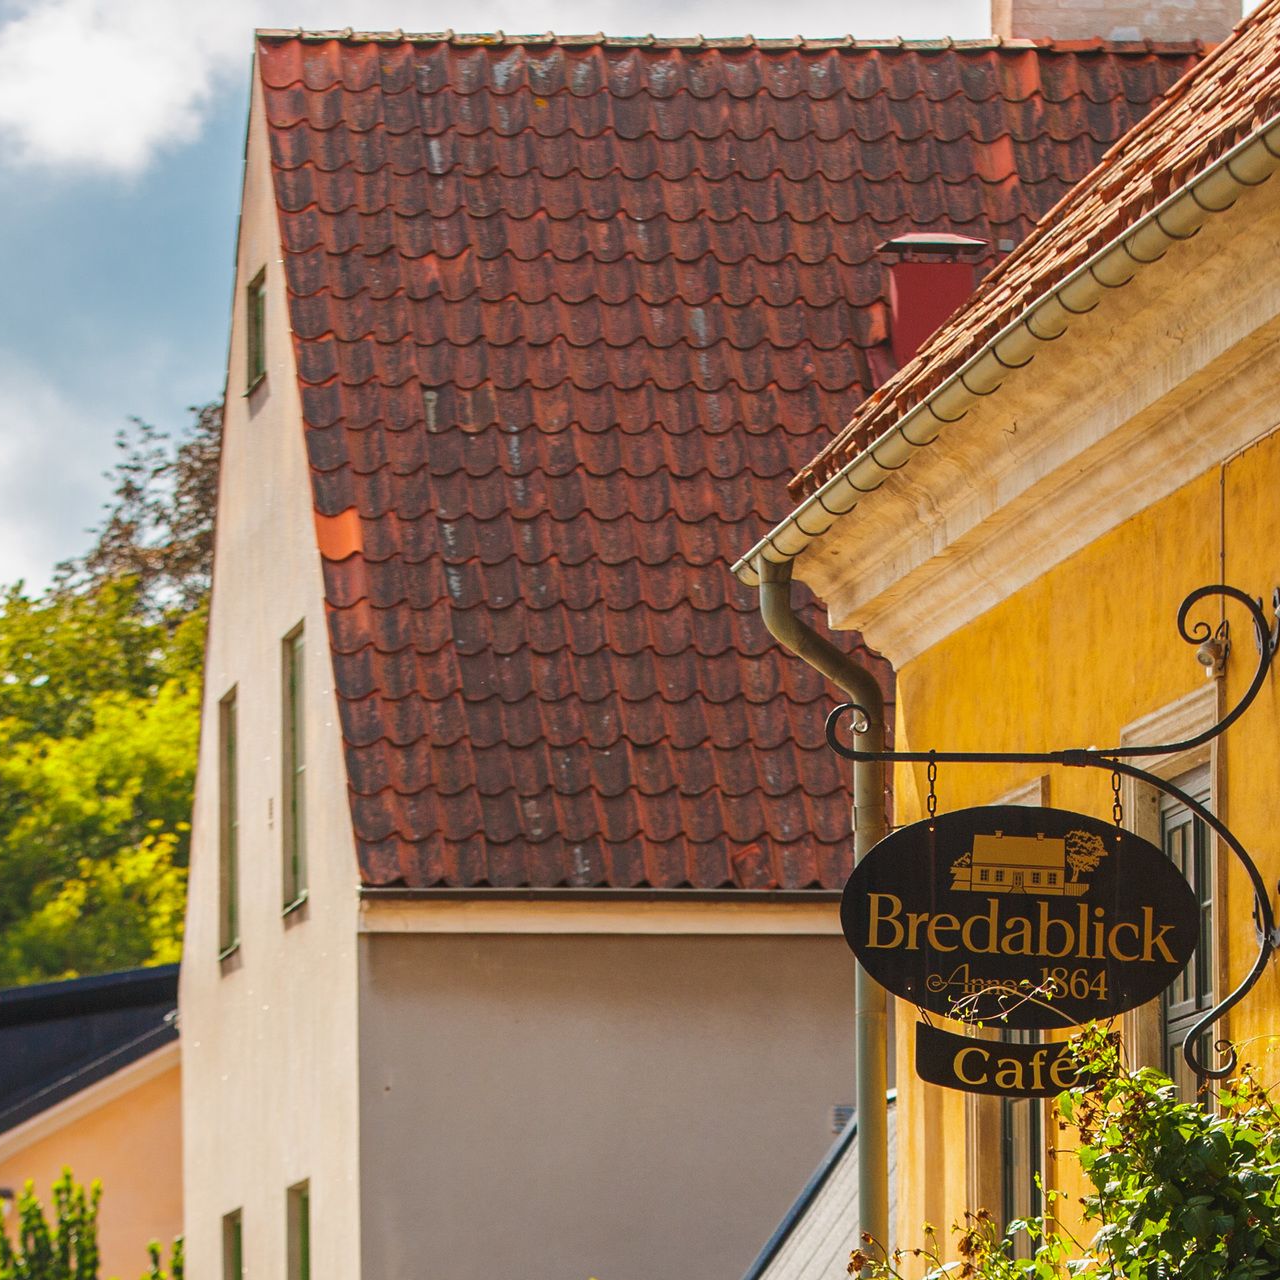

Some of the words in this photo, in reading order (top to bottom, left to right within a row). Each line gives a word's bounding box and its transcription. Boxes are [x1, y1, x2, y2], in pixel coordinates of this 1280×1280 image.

[865, 892, 1178, 963] Bredablick
[926, 963, 1019, 996] Anno
[1039, 967, 1108, 1000] 1864
[953, 1047, 1080, 1091] Café
